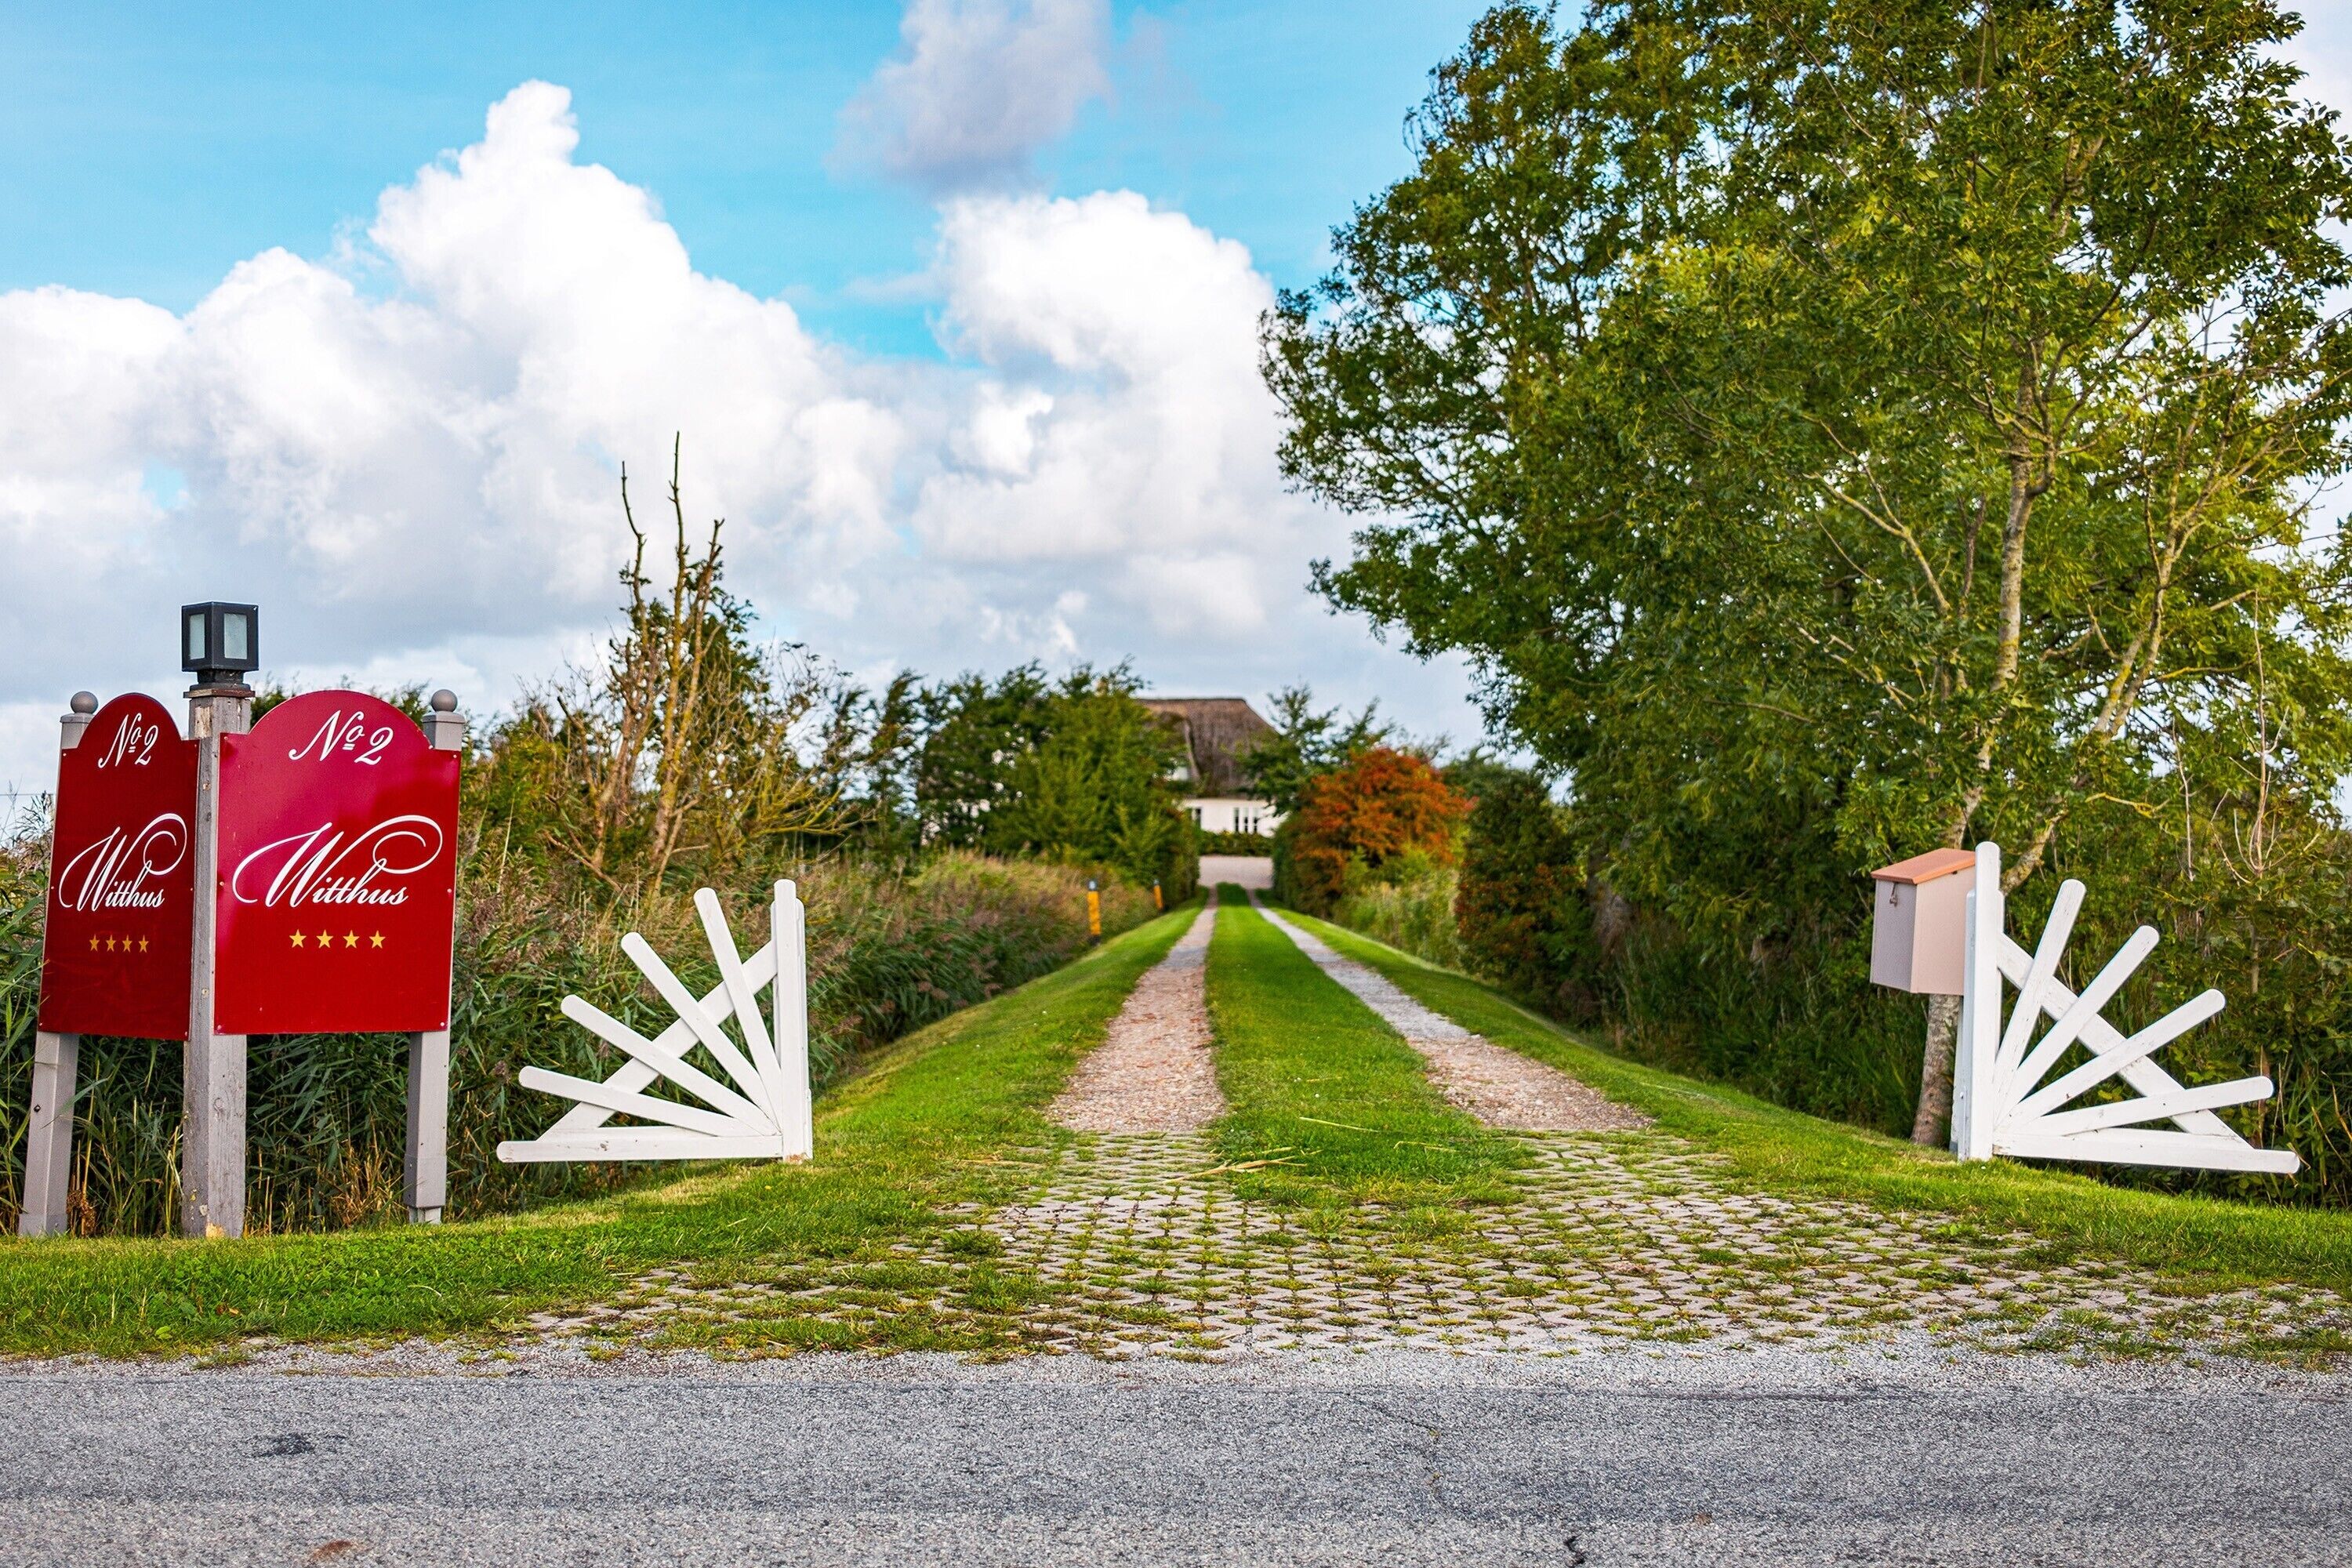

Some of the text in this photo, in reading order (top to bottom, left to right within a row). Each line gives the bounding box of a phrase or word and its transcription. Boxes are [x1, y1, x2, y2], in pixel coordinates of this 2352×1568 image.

[134, 725, 159, 766] 2
[354, 727, 394, 765] 2
[59, 813, 187, 912] Witthus
[232, 815, 443, 908] Witthus
